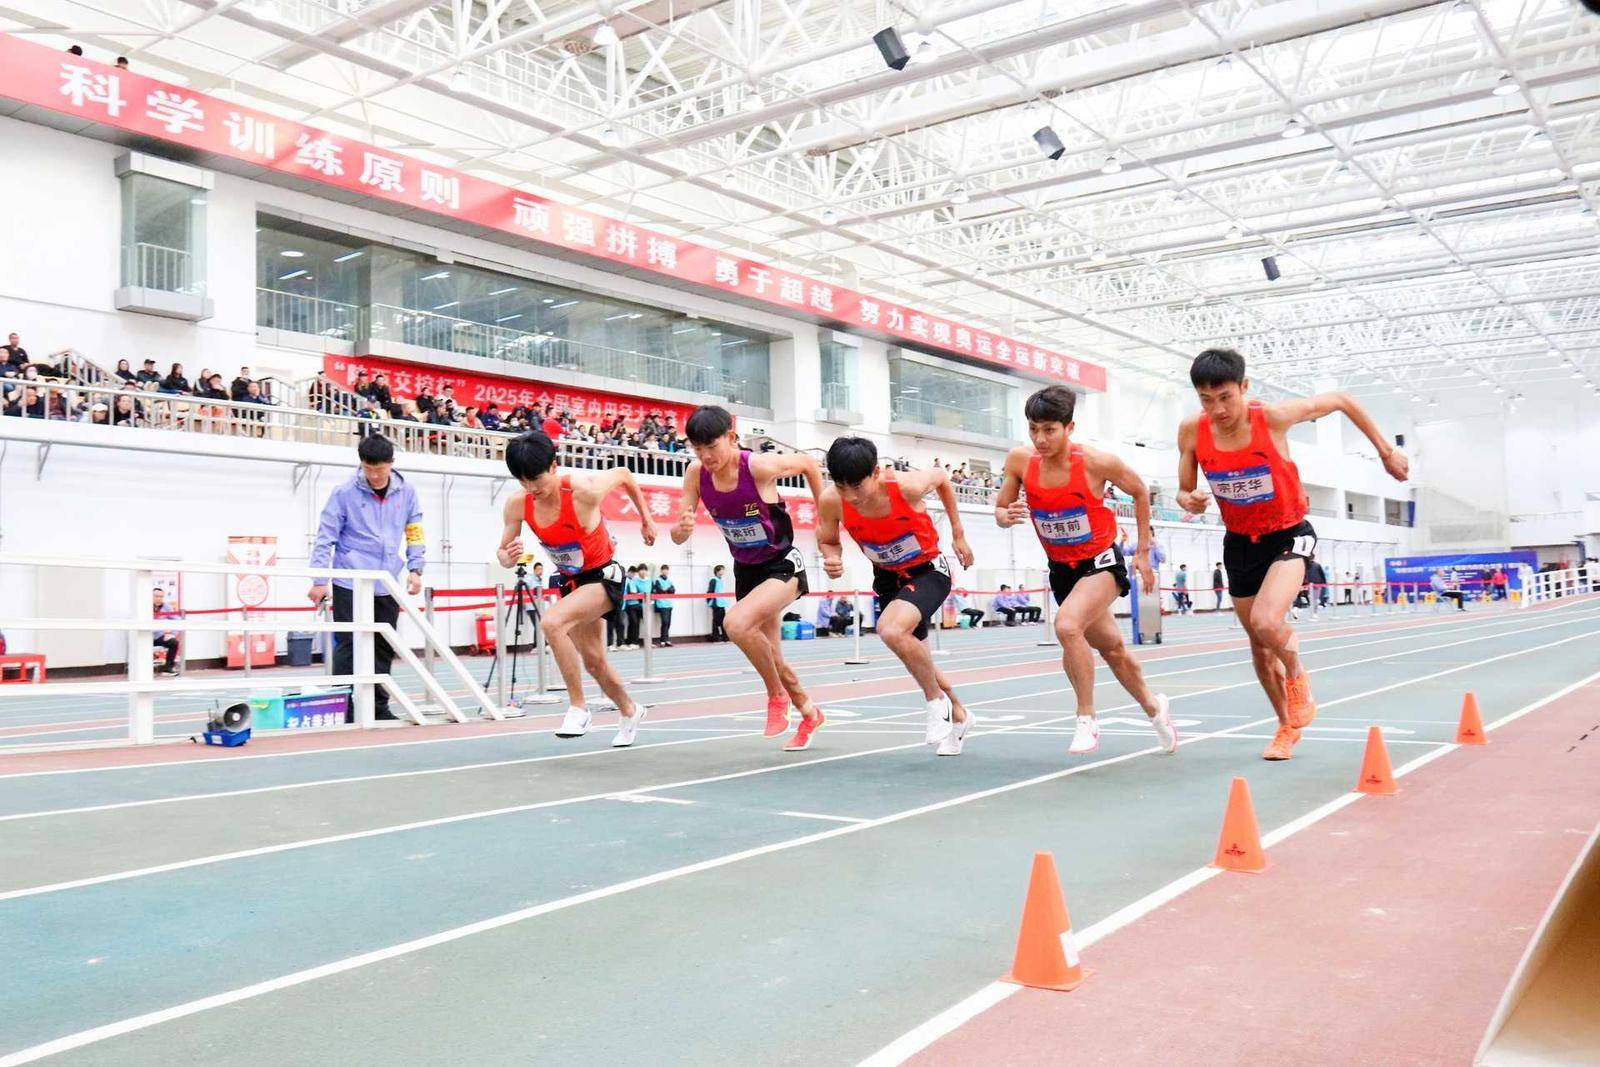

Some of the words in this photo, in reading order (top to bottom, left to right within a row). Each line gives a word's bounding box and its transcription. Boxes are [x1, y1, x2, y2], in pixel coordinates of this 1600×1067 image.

[59, 63, 461, 209] 科学训练原则
[513, 197, 679, 270] 顽强拼搏
[714, 258, 834, 313] 勇于超越
[859, 299, 1081, 382] 努力实现奥运全运新突破
[1216, 478, 1263, 494] 宗庆华
[1041, 519, 1081, 534] 付有前
[1099, 553, 1112, 565] 2
